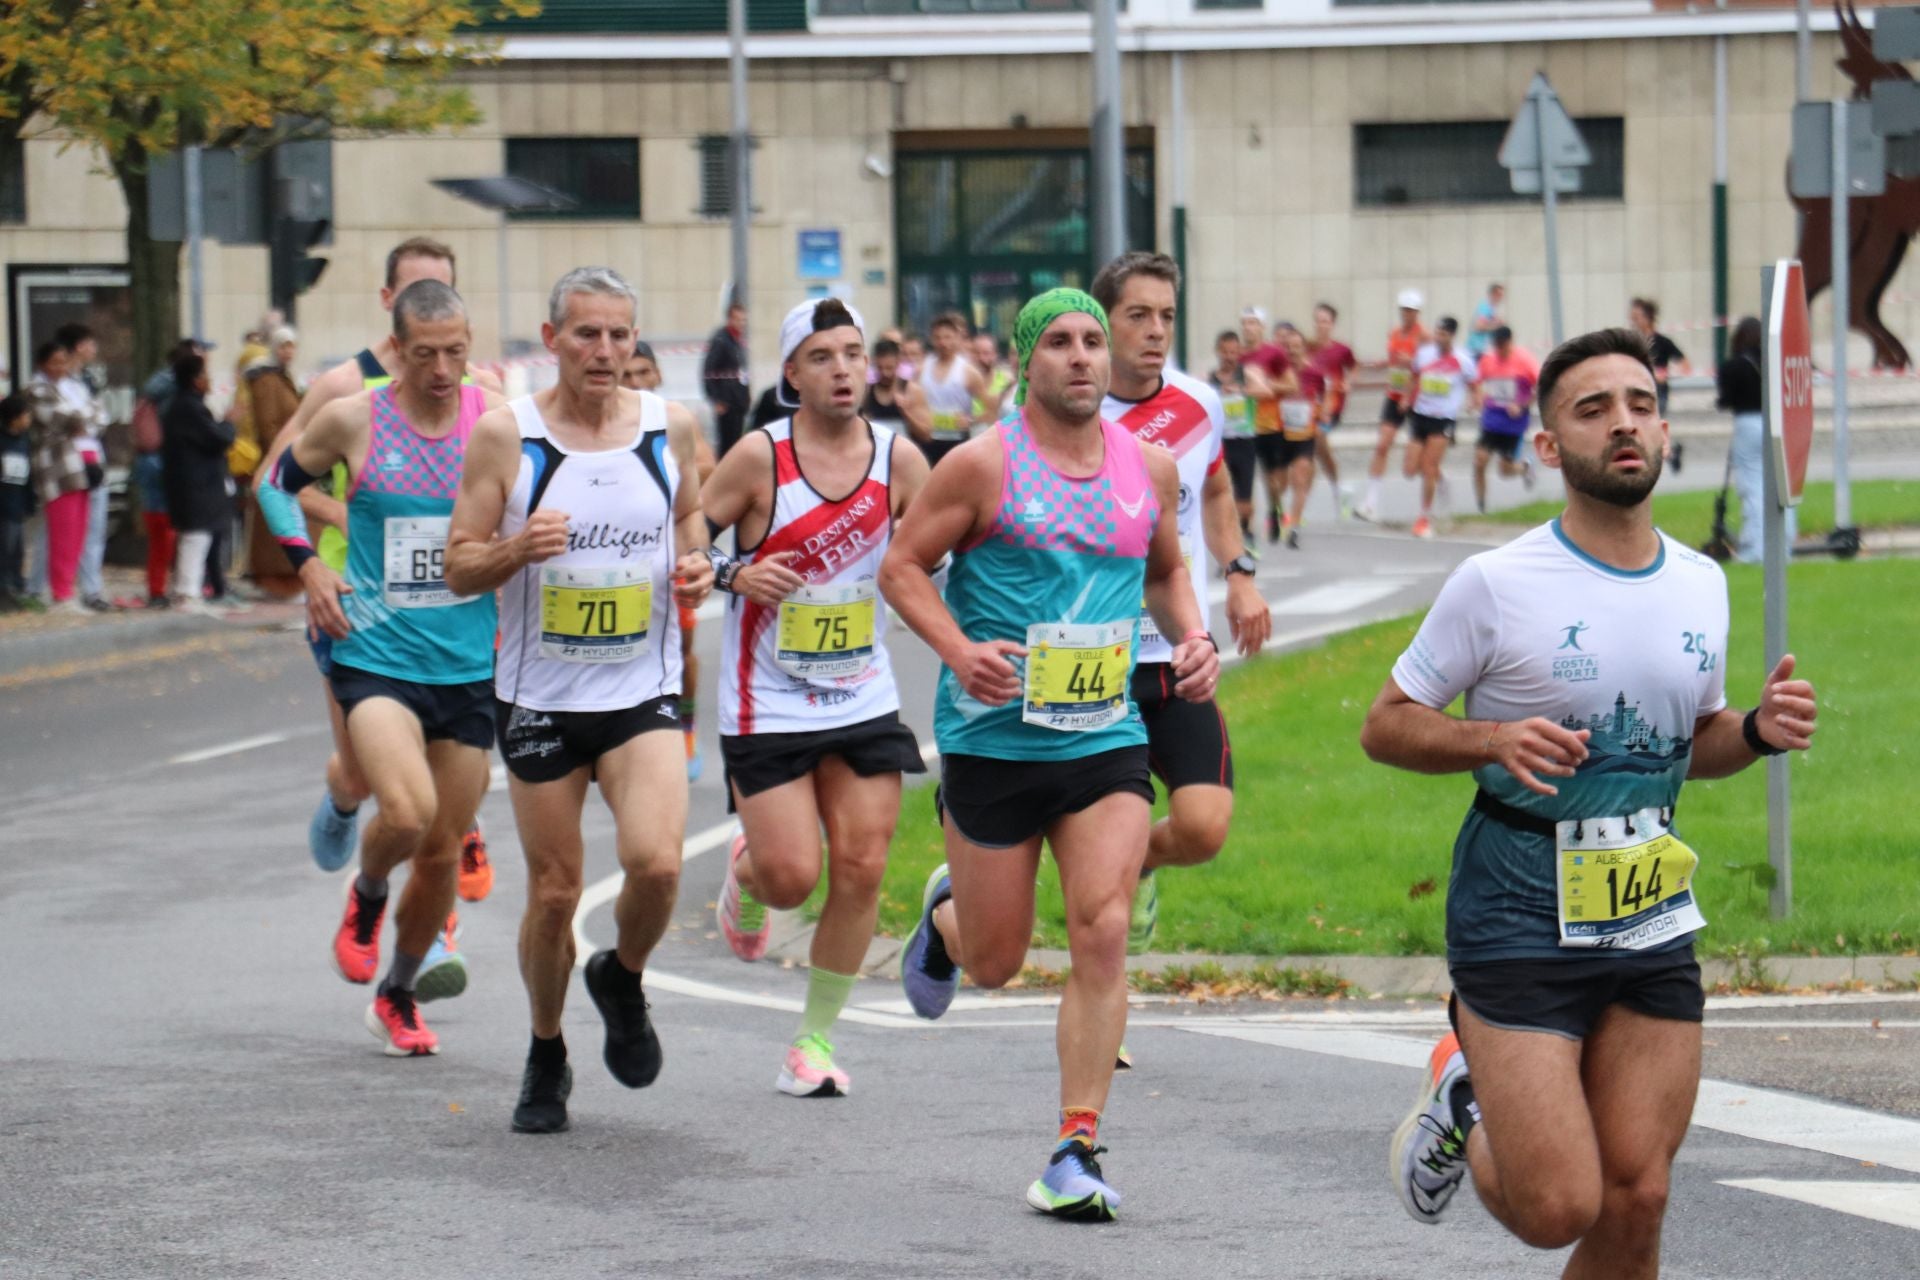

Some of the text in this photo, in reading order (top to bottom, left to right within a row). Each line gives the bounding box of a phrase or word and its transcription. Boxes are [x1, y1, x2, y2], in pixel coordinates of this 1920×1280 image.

[1784, 356, 1810, 408] STOP
[566, 523, 663, 558] telligent
[804, 495, 875, 555] DESPENSA
[819, 530, 872, 574] FER
[577, 600, 616, 635] 70
[814, 615, 848, 651] 75
[582, 645, 634, 657] HYUNDAI
[815, 660, 860, 672] HYUNDAI
[1552, 658, 1594, 670] COSTA
[1066, 661, 1106, 701] 44
[1552, 667, 1599, 679] MORTE
[1070, 709, 1113, 725] HYUNDAI
[1605, 857, 1663, 918] 144
[1621, 914, 1678, 945] HYUNDAI
